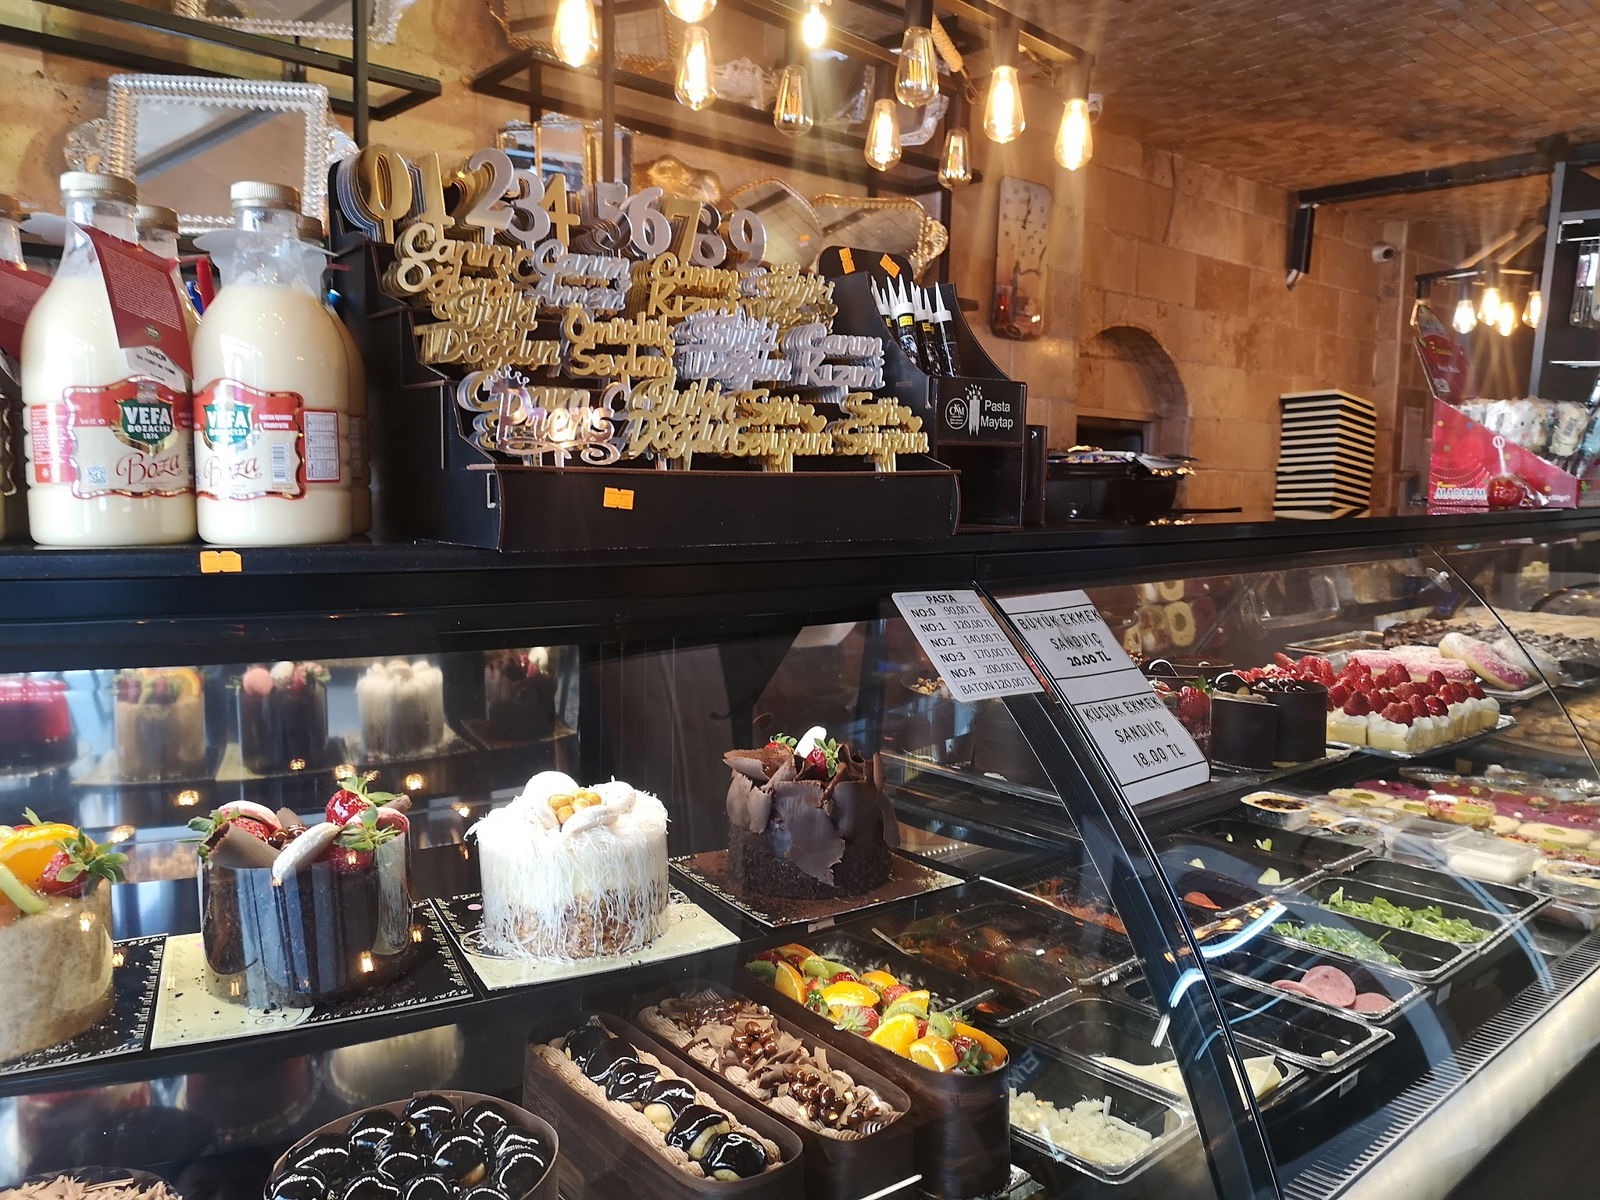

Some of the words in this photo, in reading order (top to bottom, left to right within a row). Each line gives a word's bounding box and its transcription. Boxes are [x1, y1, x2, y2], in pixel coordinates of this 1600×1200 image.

[414, 151, 456, 230] 1
[466, 148, 514, 230] 2
[508, 169, 551, 243] 3
[545, 173, 580, 240] 4
[629, 187, 672, 256] 6
[665, 195, 701, 264] 7
[693, 202, 727, 267] 8
[729, 209, 767, 267] 9
[984, 400, 1011, 413] Pasta
[123, 407, 172, 425] VEFA
[980, 415, 1014, 430] Maytap
[116, 452, 184, 485] Boza
[204, 455, 262, 487] Bza
[925, 594, 957, 604] PASTA
[910, 607, 936, 618] NO:0
[943, 605, 969, 616] 90,00
[967, 605, 980, 614] TL
[1017, 614, 1060, 630] BÜYÜK
[1060, 609, 1102, 626] EKMEK
[920, 622, 946, 633] NO:1
[954, 619, 983, 630] 120,00
[982, 619, 995, 628] TL
[930, 637, 956, 648] NO:2
[963, 633, 994, 644] 140,00
[993, 632, 1006, 642] TL
[1049, 632, 1104, 651] SANDVİÇ
[940, 651, 966, 663] NO:3
[973, 648, 1004, 659] 170,00
[1002, 647, 1015, 656] TL
[1066, 653, 1098, 667] 20.00
[1095, 650, 1112, 662] TL
[950, 667, 977, 679] NO:4
[983, 662, 1014, 674] 200,00
[1012, 662, 1025, 670] TL
[960, 682, 995, 695] BATON
[994, 677, 1025, 689] 120,00
[1023, 676, 1037, 685] TL
[1082, 703, 1125, 722] KÜÇÜK
[1122, 697, 1163, 713] EKMEK
[1115, 720, 1168, 744] SANDVİÇ
[1133, 747, 1168, 768] 18.00
[1166, 743, 1186, 758] TL
